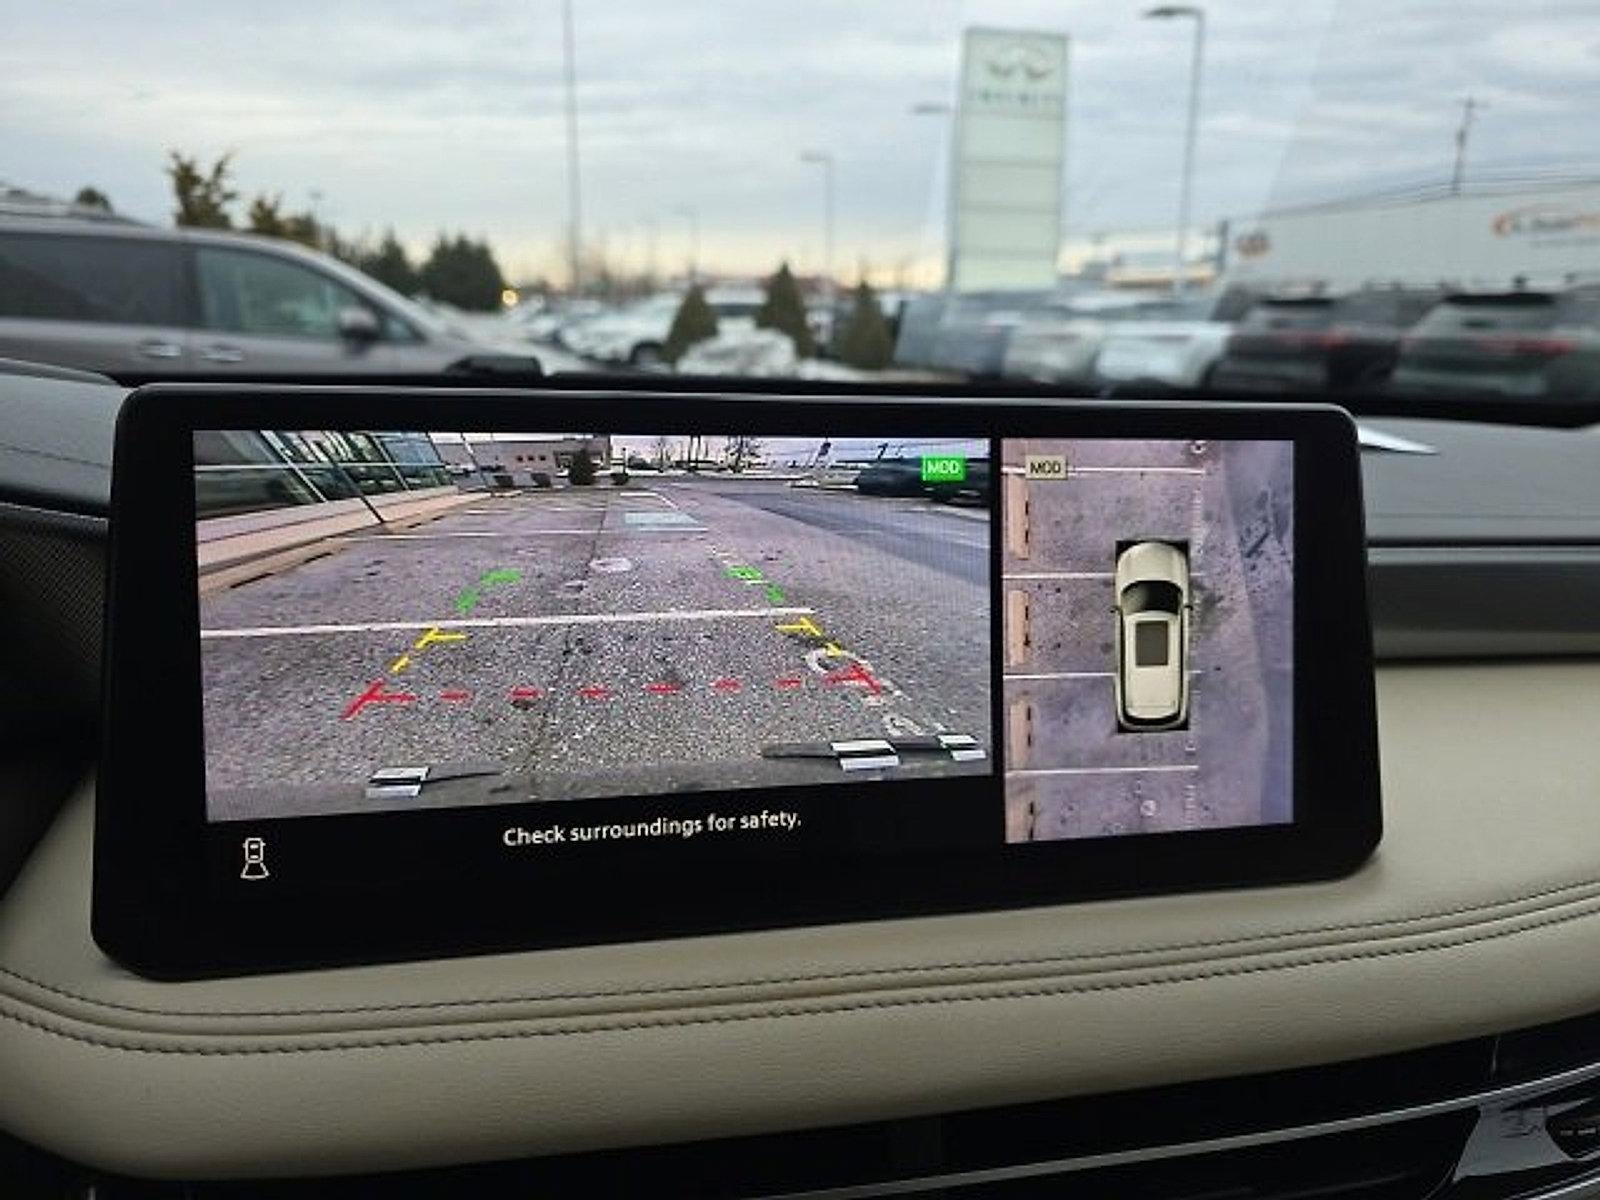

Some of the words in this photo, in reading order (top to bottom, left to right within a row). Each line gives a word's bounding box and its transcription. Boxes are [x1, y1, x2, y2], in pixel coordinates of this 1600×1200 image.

[927, 460, 961, 475] MOD
[1029, 461, 1062, 475] MOD
[503, 825, 566, 847] Check
[570, 816, 703, 842] surroundings
[707, 813, 736, 831] for
[740, 810, 801, 831] safety.
